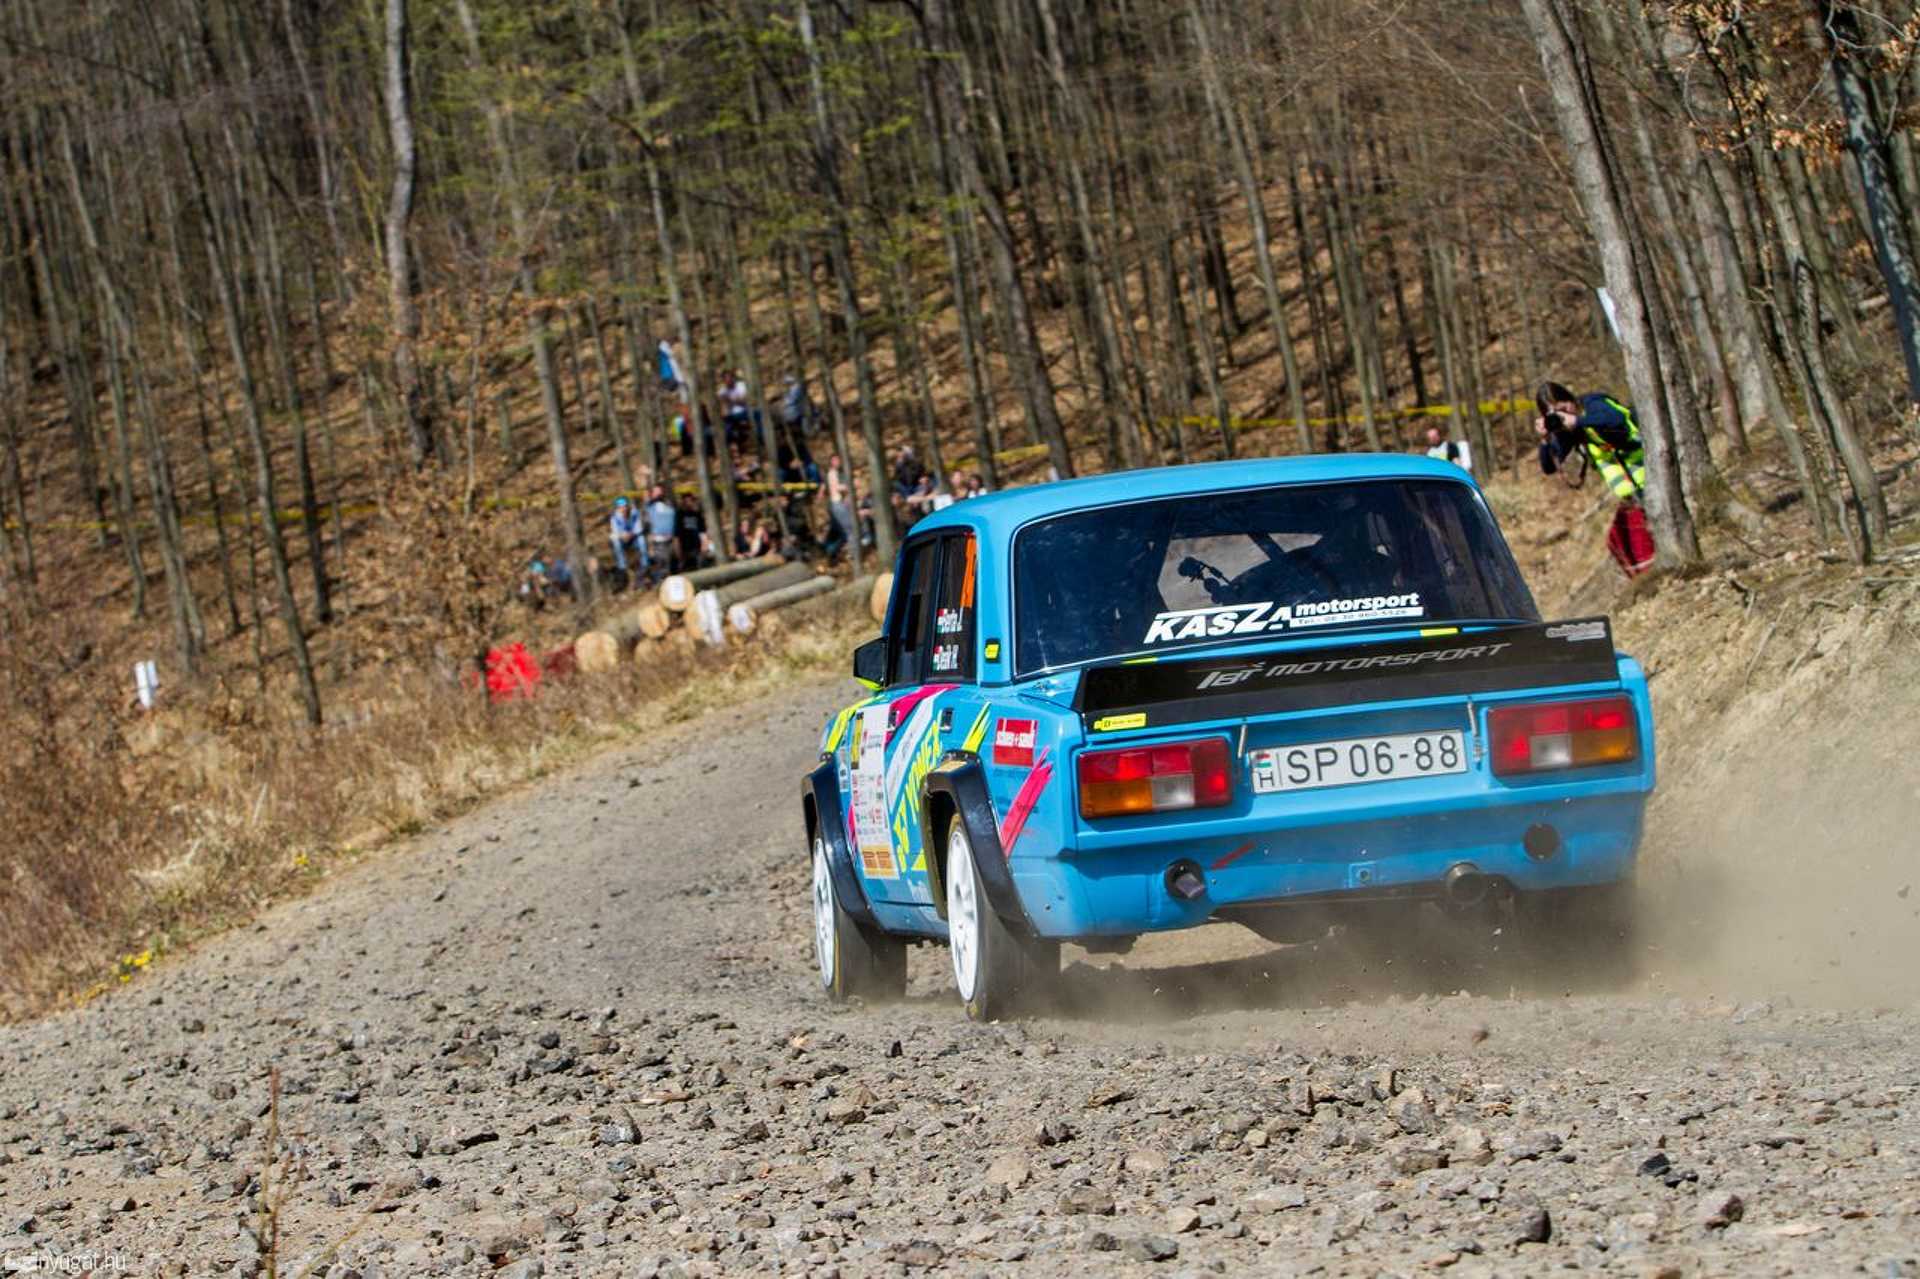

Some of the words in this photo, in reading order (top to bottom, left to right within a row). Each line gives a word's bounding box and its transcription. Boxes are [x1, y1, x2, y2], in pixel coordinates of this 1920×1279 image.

[1296, 592, 1419, 616] motorsport
[1266, 642, 1512, 677] MOTORSPORT
[1286, 746, 1339, 784] SP
[1349, 735, 1458, 777] 06-88
[1259, 771, 1275, 788] H
